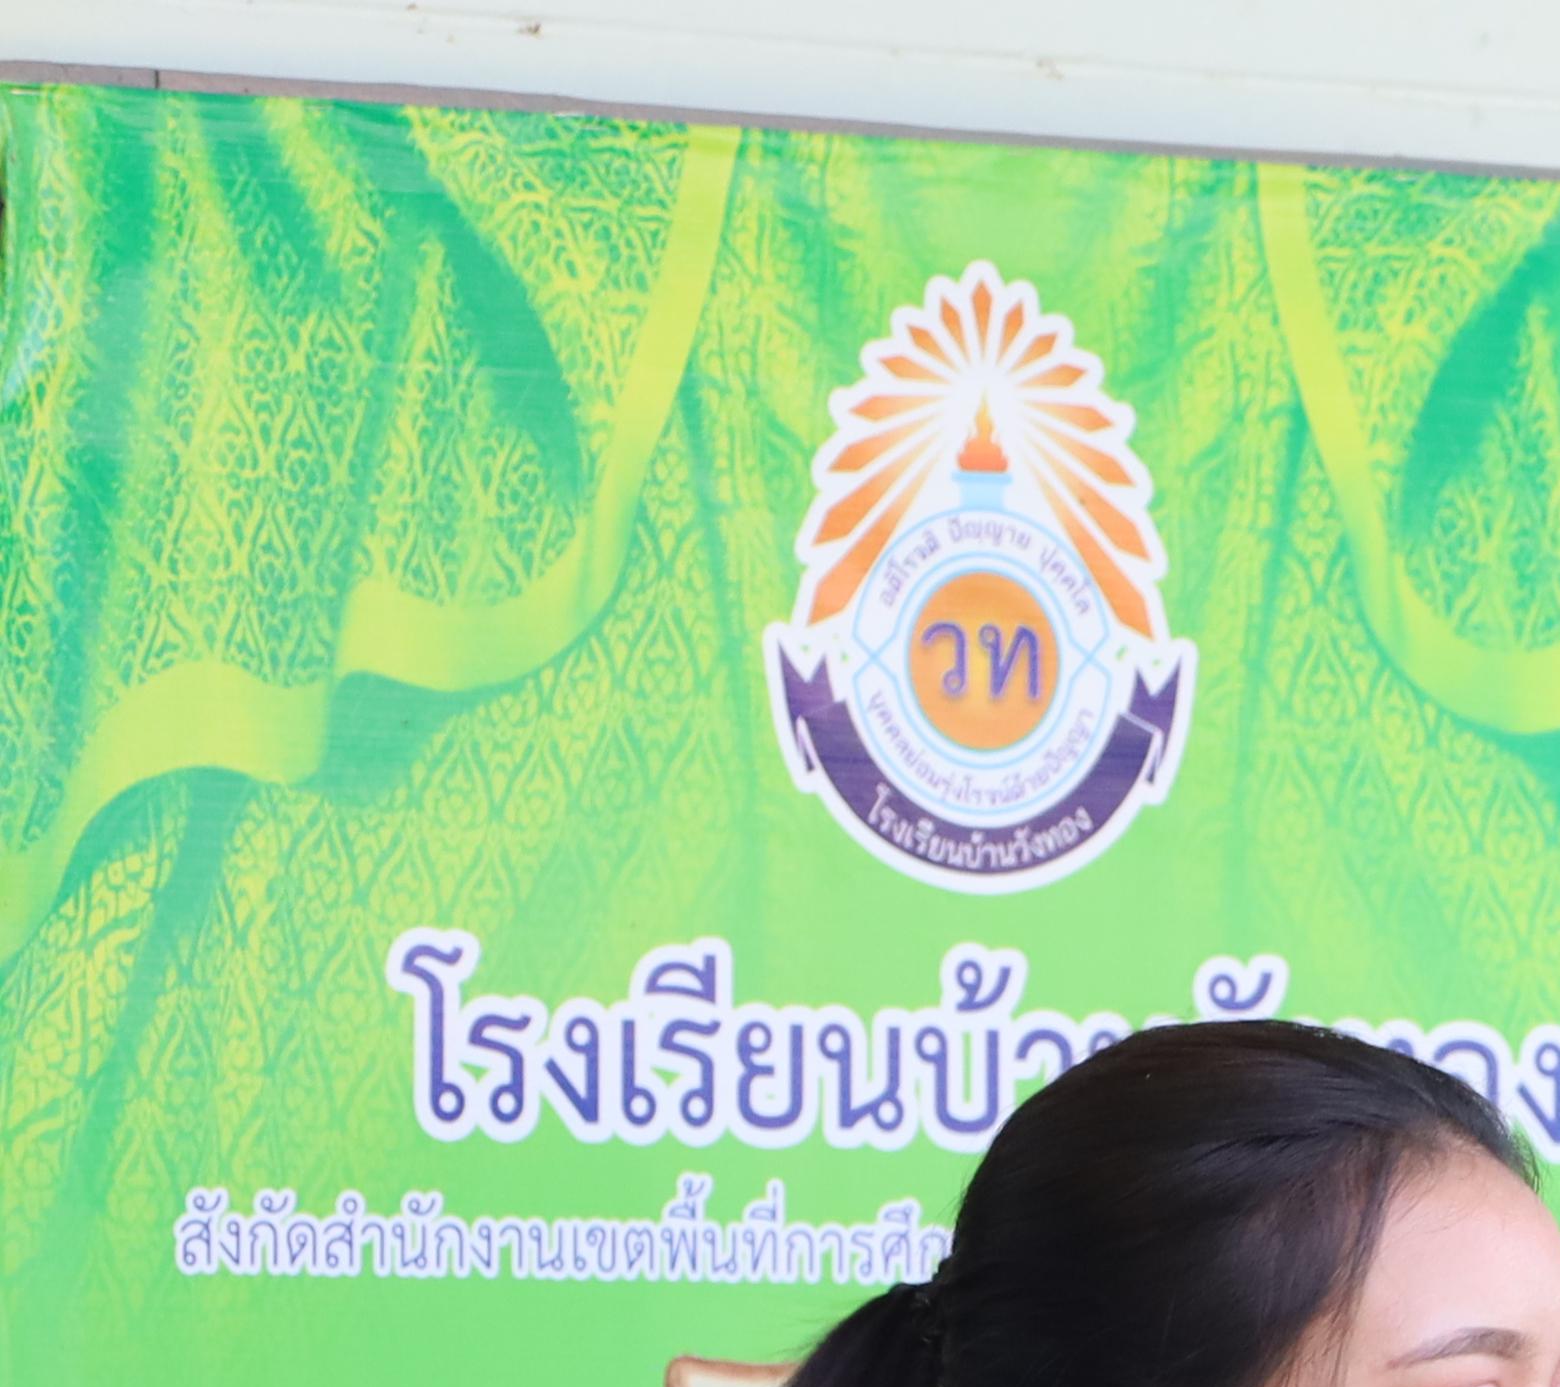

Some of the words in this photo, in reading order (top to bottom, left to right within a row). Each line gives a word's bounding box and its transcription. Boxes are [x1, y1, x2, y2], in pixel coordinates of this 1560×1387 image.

[921, 621, 1041, 699] วท
[867, 785, 1095, 870] โรงเรียนบ้านวังทอง
[179, 1176, 948, 1277] สังกัดสำนักงานเขตพื้นที่การศึก
